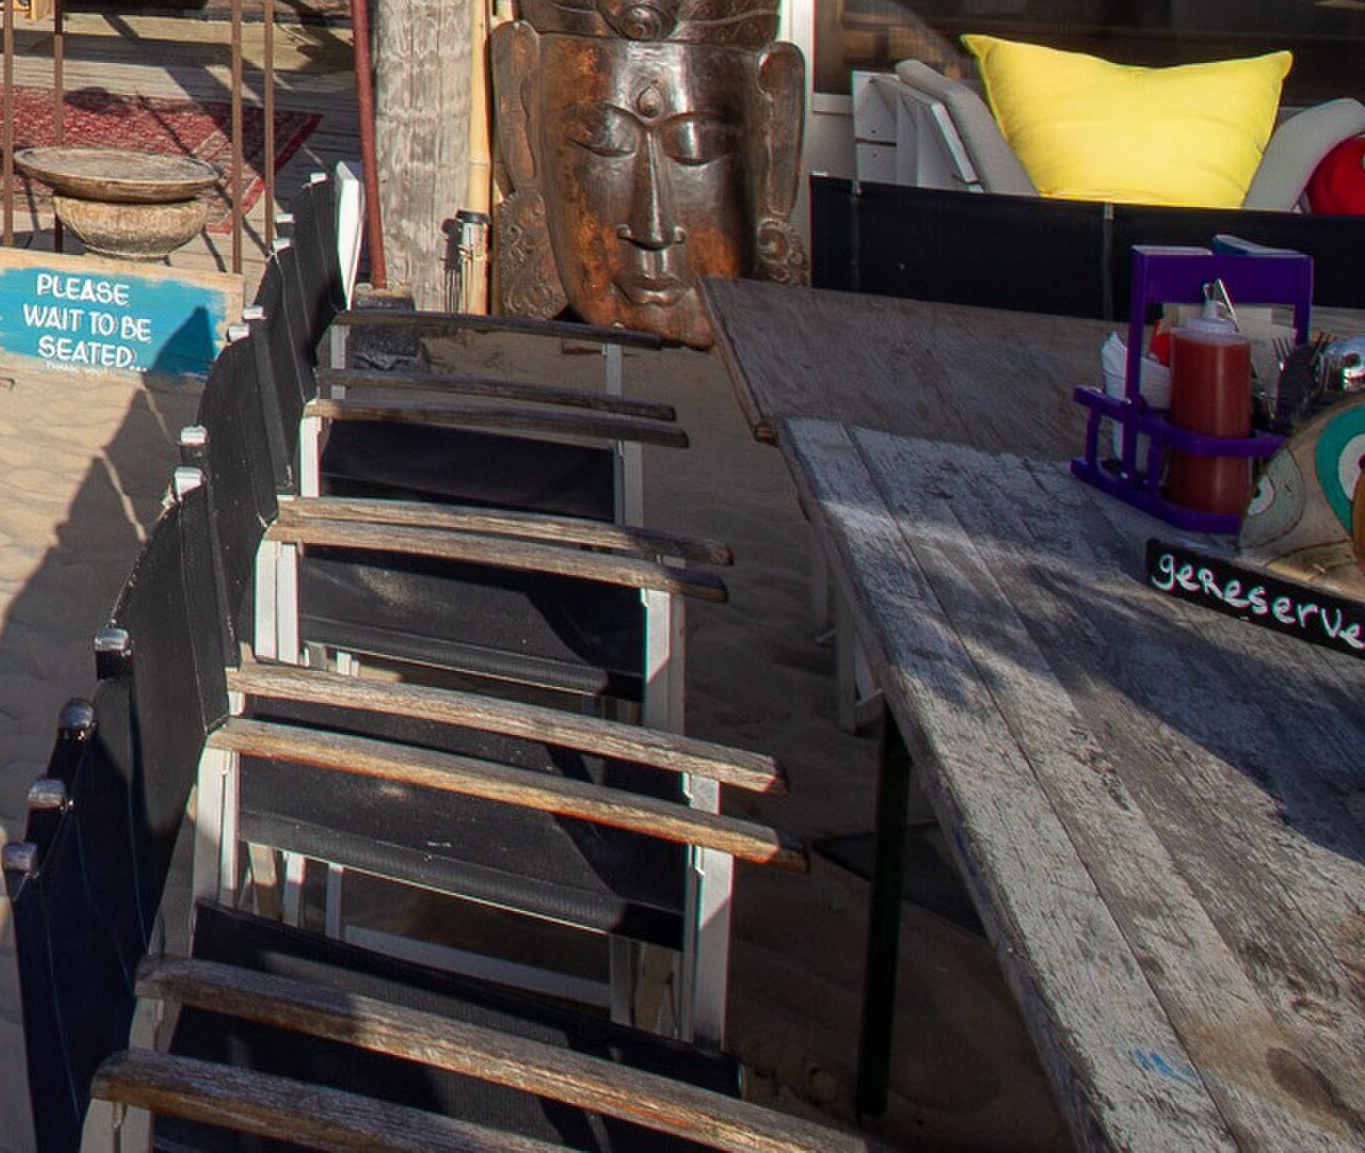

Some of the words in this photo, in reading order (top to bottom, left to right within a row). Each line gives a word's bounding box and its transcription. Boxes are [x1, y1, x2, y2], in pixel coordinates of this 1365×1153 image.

[35, 273, 130, 306] PLEASE
[23, 303, 85, 331] WAIT
[89, 311, 117, 336] TO
[121, 317, 152, 343] BE
